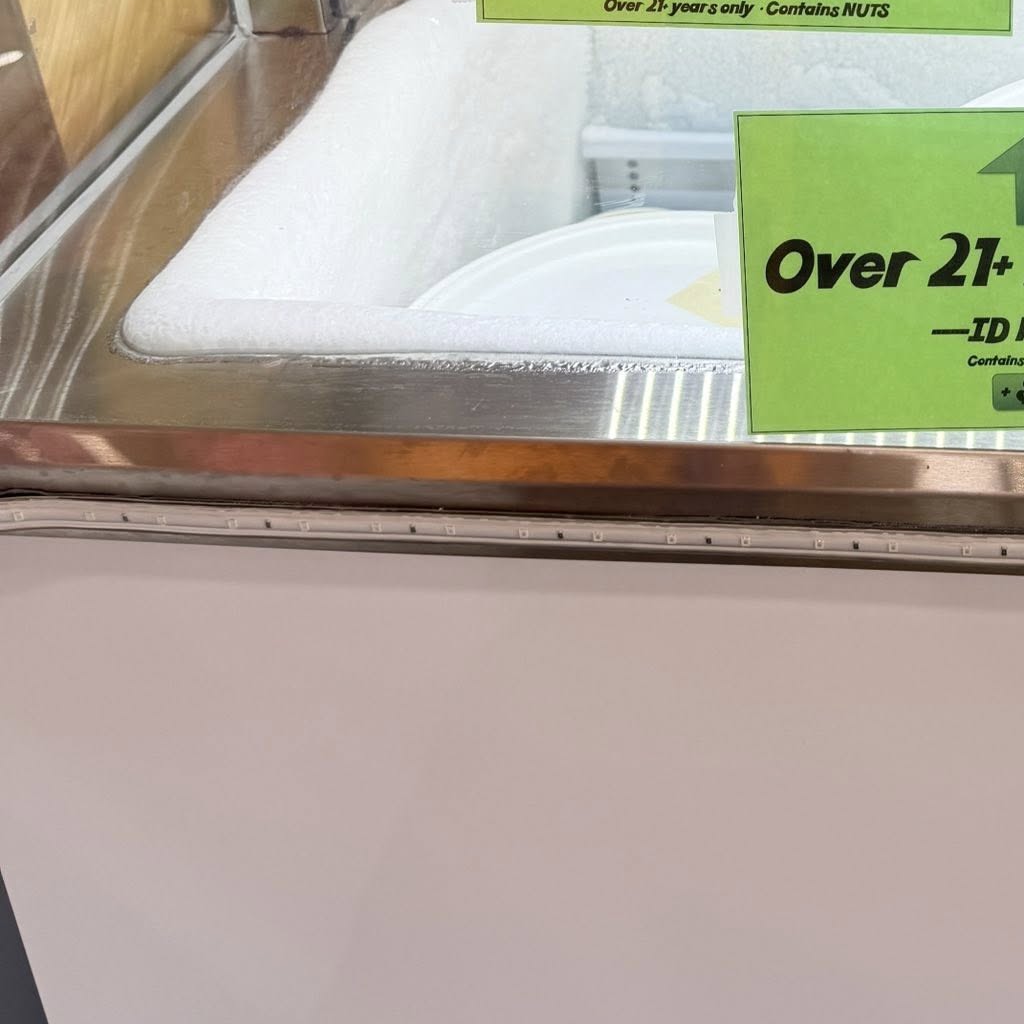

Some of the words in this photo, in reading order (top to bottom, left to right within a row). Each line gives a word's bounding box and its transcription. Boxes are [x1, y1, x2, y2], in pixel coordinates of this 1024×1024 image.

[668, 3, 718, 16] years
[720, 1, 754, 18] only
[766, 1, 840, 17] Contains
[842, 3, 890, 18] NUTS
[766, 239, 920, 294] Over
[928, 232, 1013, 287] 21+
[968, 355, 1024, 366] Contains
